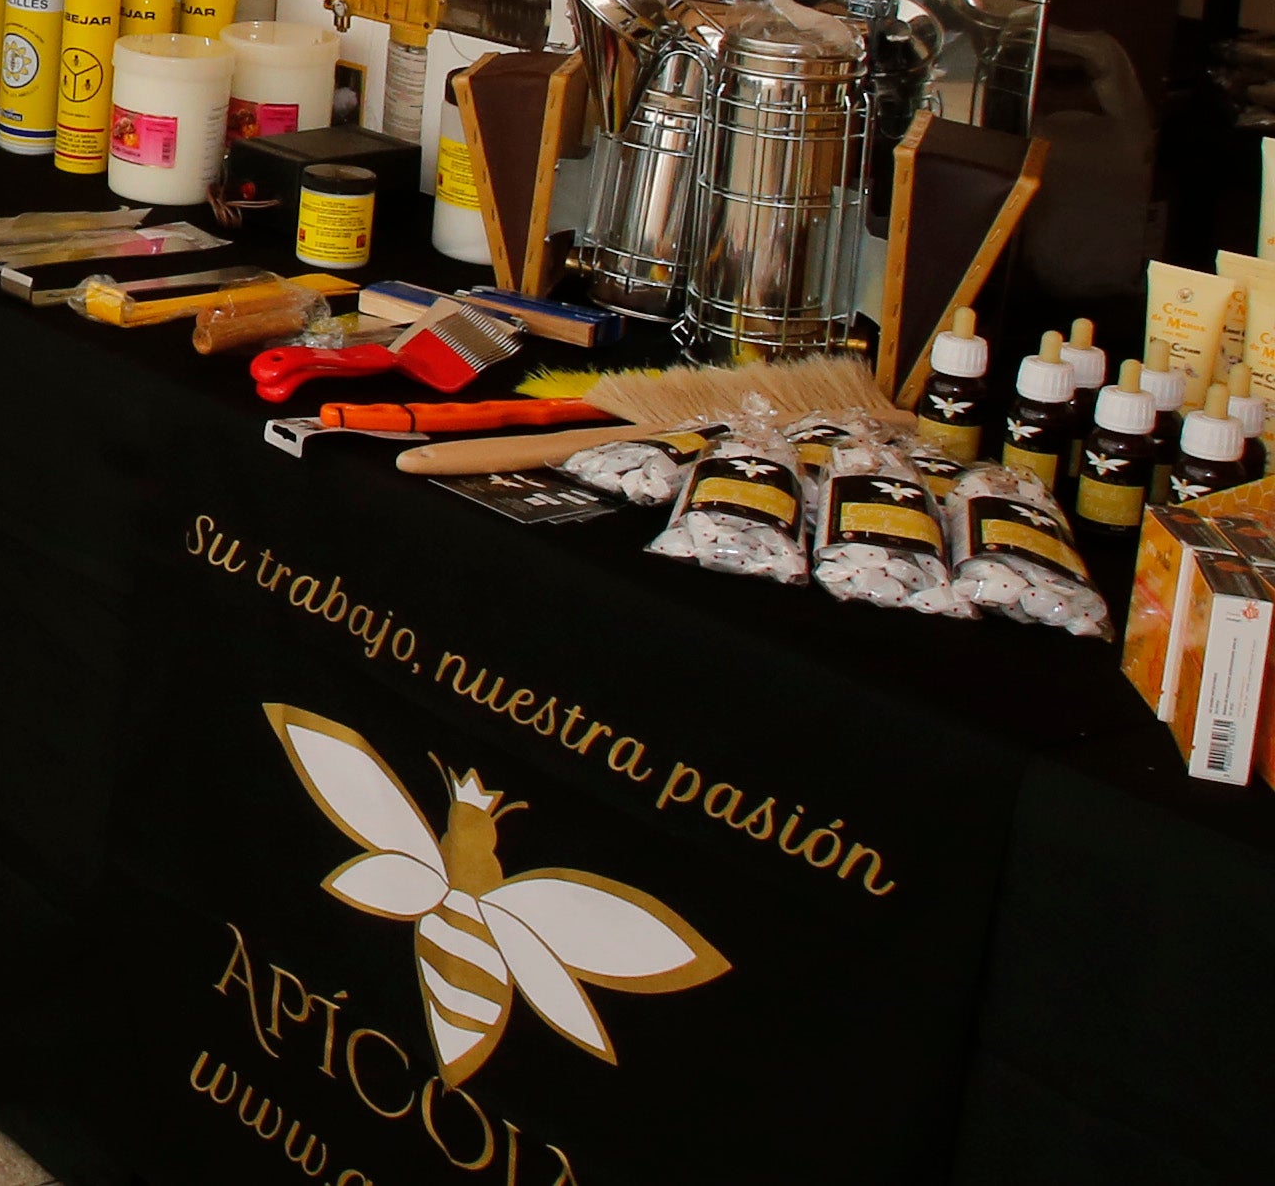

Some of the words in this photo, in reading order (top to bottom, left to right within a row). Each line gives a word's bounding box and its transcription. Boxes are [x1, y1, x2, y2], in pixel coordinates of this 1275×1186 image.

[1162, 302, 1200, 318] Crema
[187, 514, 247, 573] Su
[256, 548, 420, 674] trabajo,
[434, 651, 653, 784] nuestra
[656, 762, 895, 896] pasión
